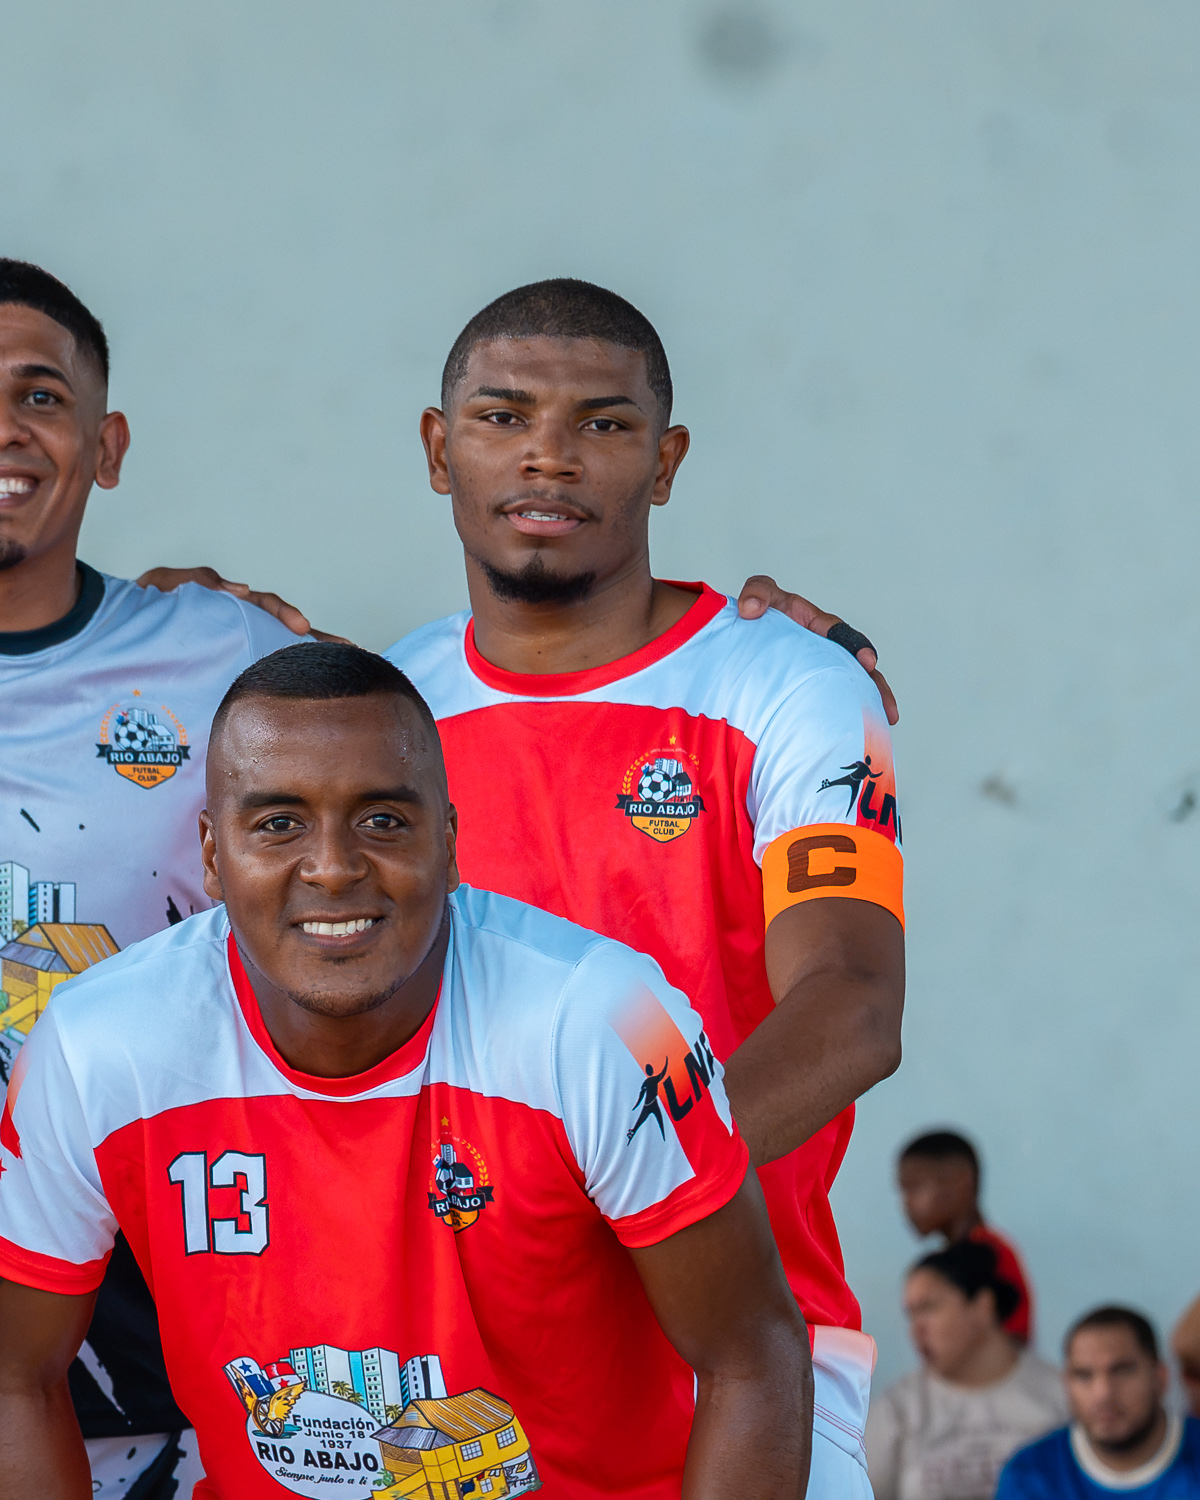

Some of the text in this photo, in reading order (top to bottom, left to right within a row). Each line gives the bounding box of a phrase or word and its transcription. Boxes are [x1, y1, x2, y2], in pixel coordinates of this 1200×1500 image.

[110, 752, 180, 764] RIO ABAJO
[628, 803, 696, 816] RIO ABAJO
[649, 819, 680, 828] FUTSAL
[653, 827, 675, 836] CLUB
[787, 834, 858, 894] C
[166, 1149, 270, 1257] 13
[292, 1414, 376, 1432] Fundación
[304, 1430, 366, 1440] Junio 18
[319, 1439, 353, 1450] 1937
[255, 1441, 379, 1472] RIO ABAJO
[275, 1466, 315, 1482] Siempre
[314, 1475, 345, 1485] junto
[358, 1476, 368, 1486] ti
